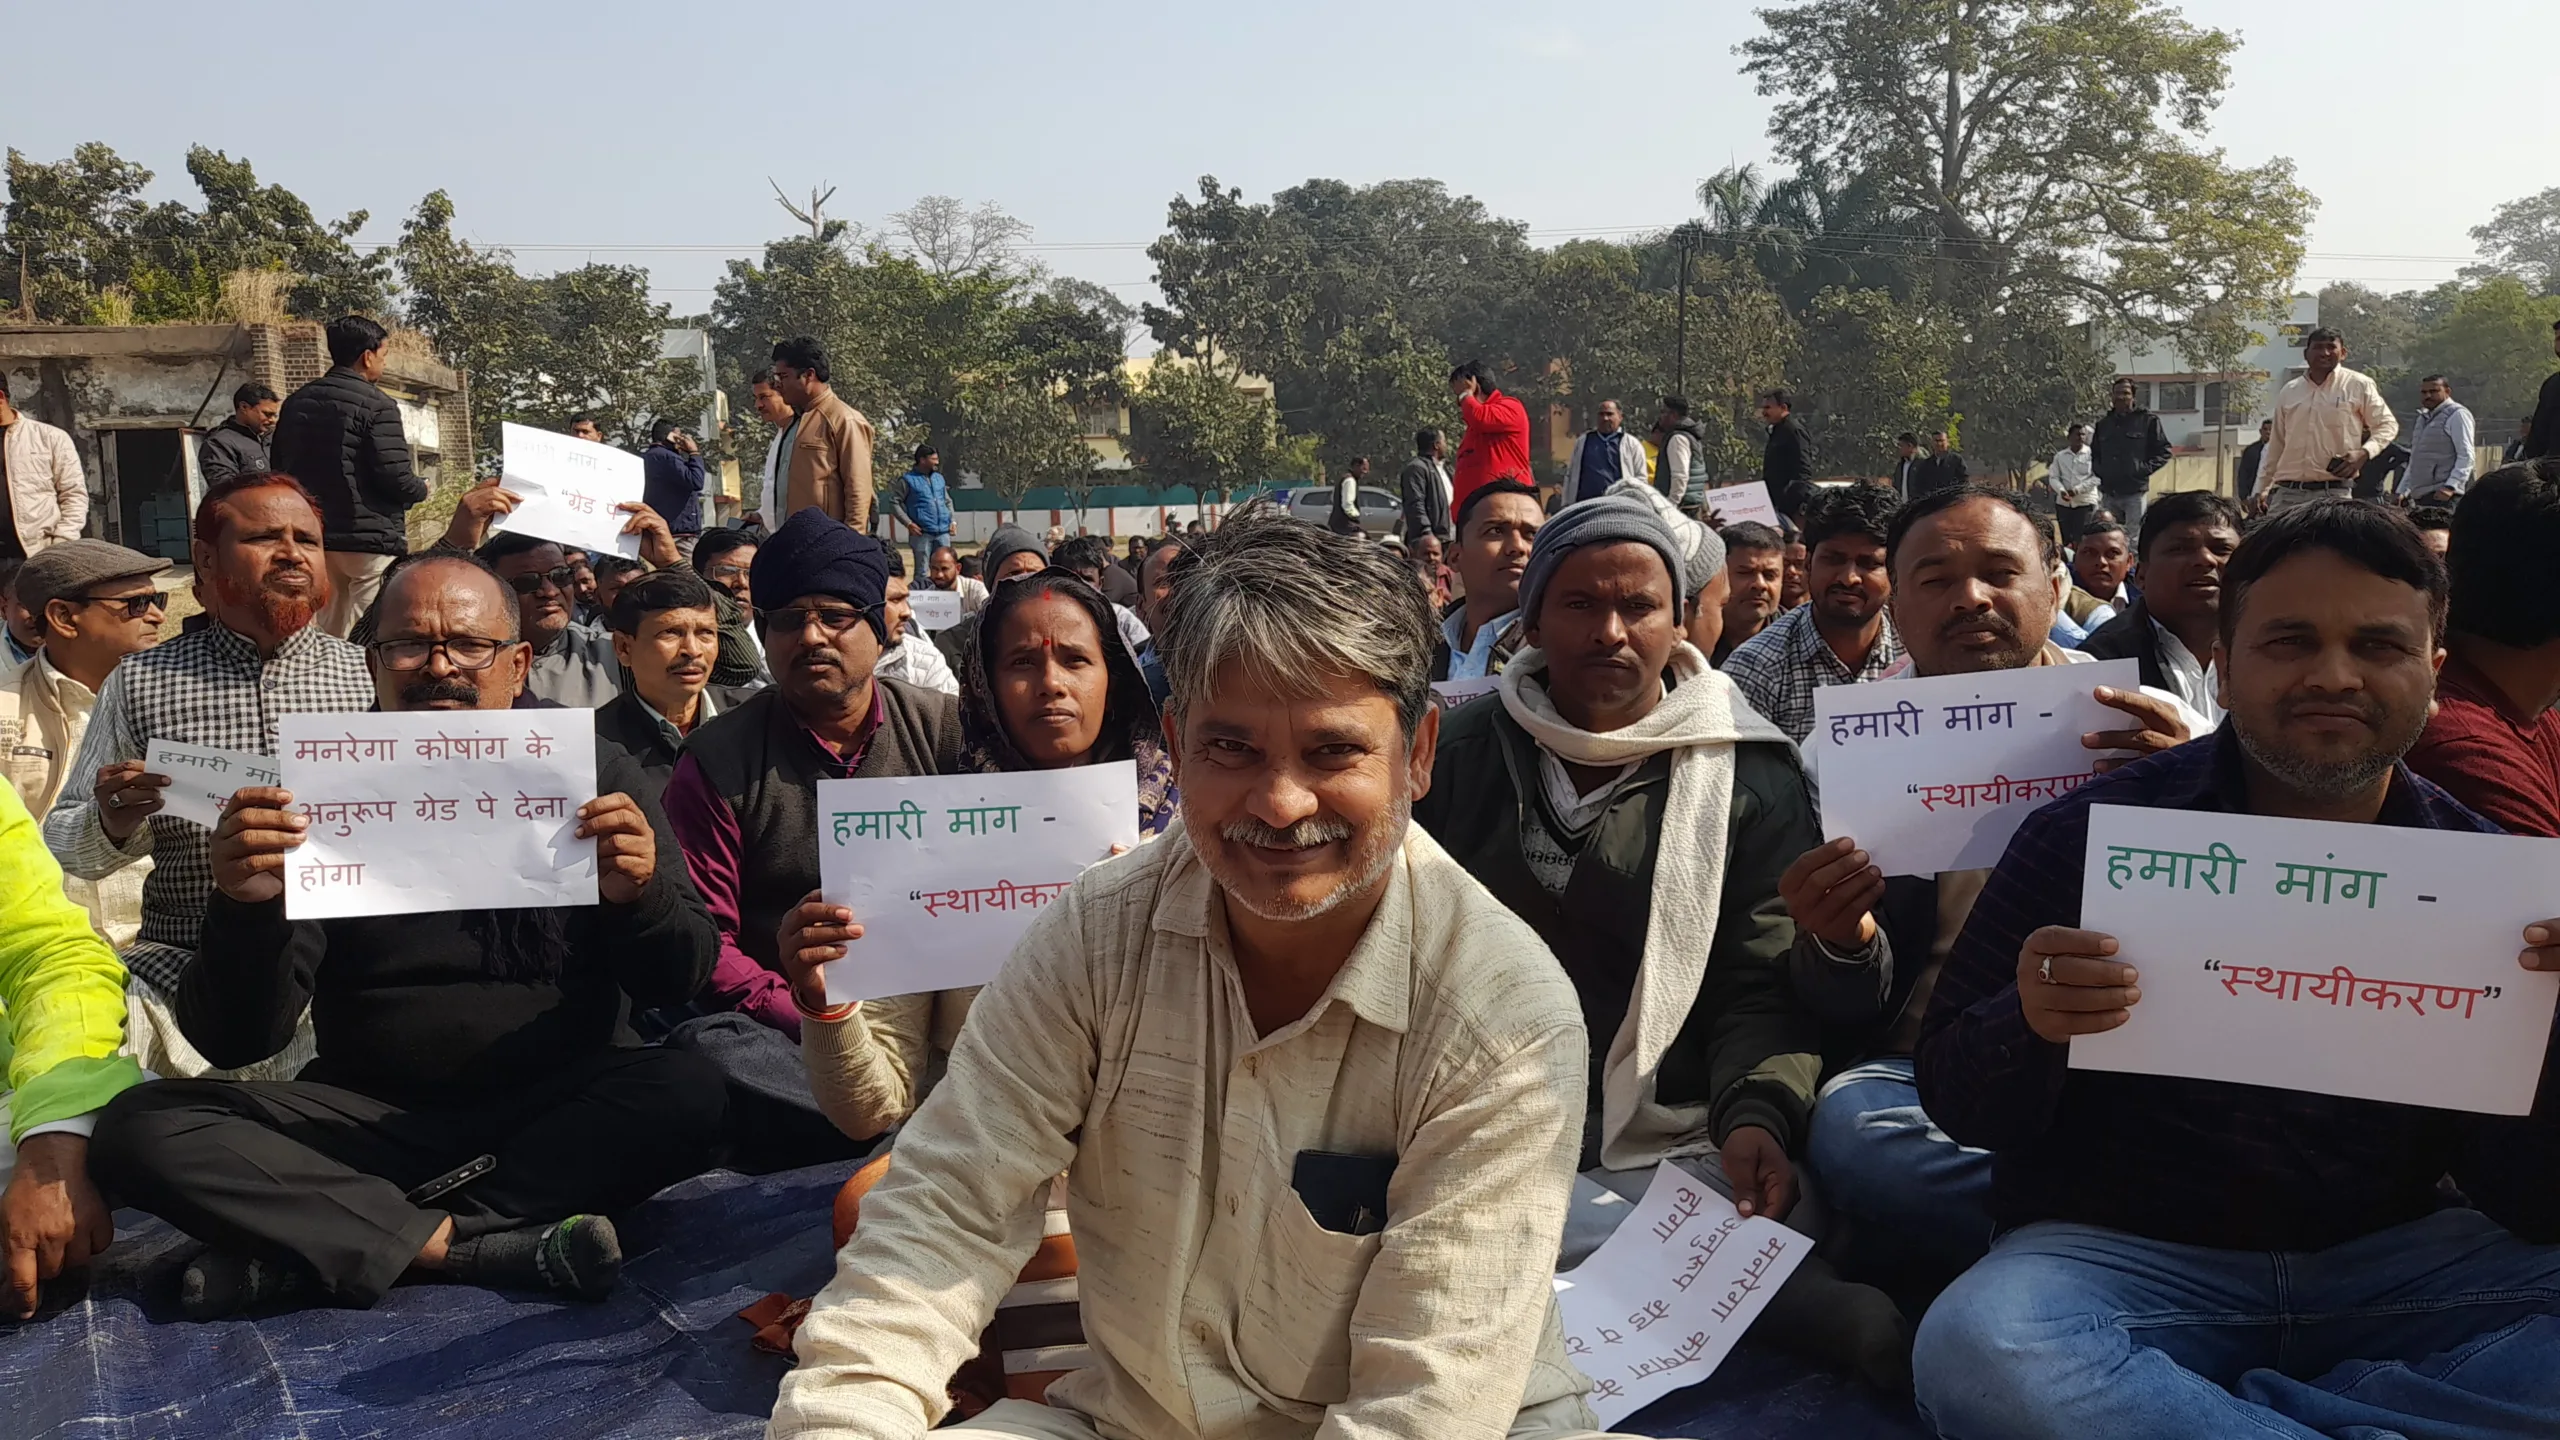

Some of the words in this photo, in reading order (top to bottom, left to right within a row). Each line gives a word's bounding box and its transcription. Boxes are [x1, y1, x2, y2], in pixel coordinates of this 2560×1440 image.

[1829, 699, 1924, 746] हमारी
[1943, 693, 2018, 732] मांग
[158, 751, 232, 773] हमारी
[294, 731, 398, 763] मनरेगा
[415, 729, 509, 761] कोषांग
[525, 729, 554, 759] के
[299, 801, 397, 837] अनुरूप
[413, 792, 459, 822] ग्रेड
[476, 790, 498, 820] पे
[514, 790, 568, 821] देना
[832, 799, 927, 847] हमारी
[947, 796, 1022, 836] मांग
[299, 857, 366, 891] होगा
[909, 879, 1072, 918] “स्थायीकर
[2107, 841, 2247, 895] हमारी
[2275, 852, 2388, 909] मांग
[2203, 958, 2502, 1019] “स्थायीकरण”
[1652, 1186, 1703, 1244] होगा
[1711, 1237, 1787, 1323] मनरेगा
[1628, 1299, 1671, 1333] ग्रेड
[1627, 1330, 1711, 1381] कोषांग
[1592, 1377, 1625, 1401] के
